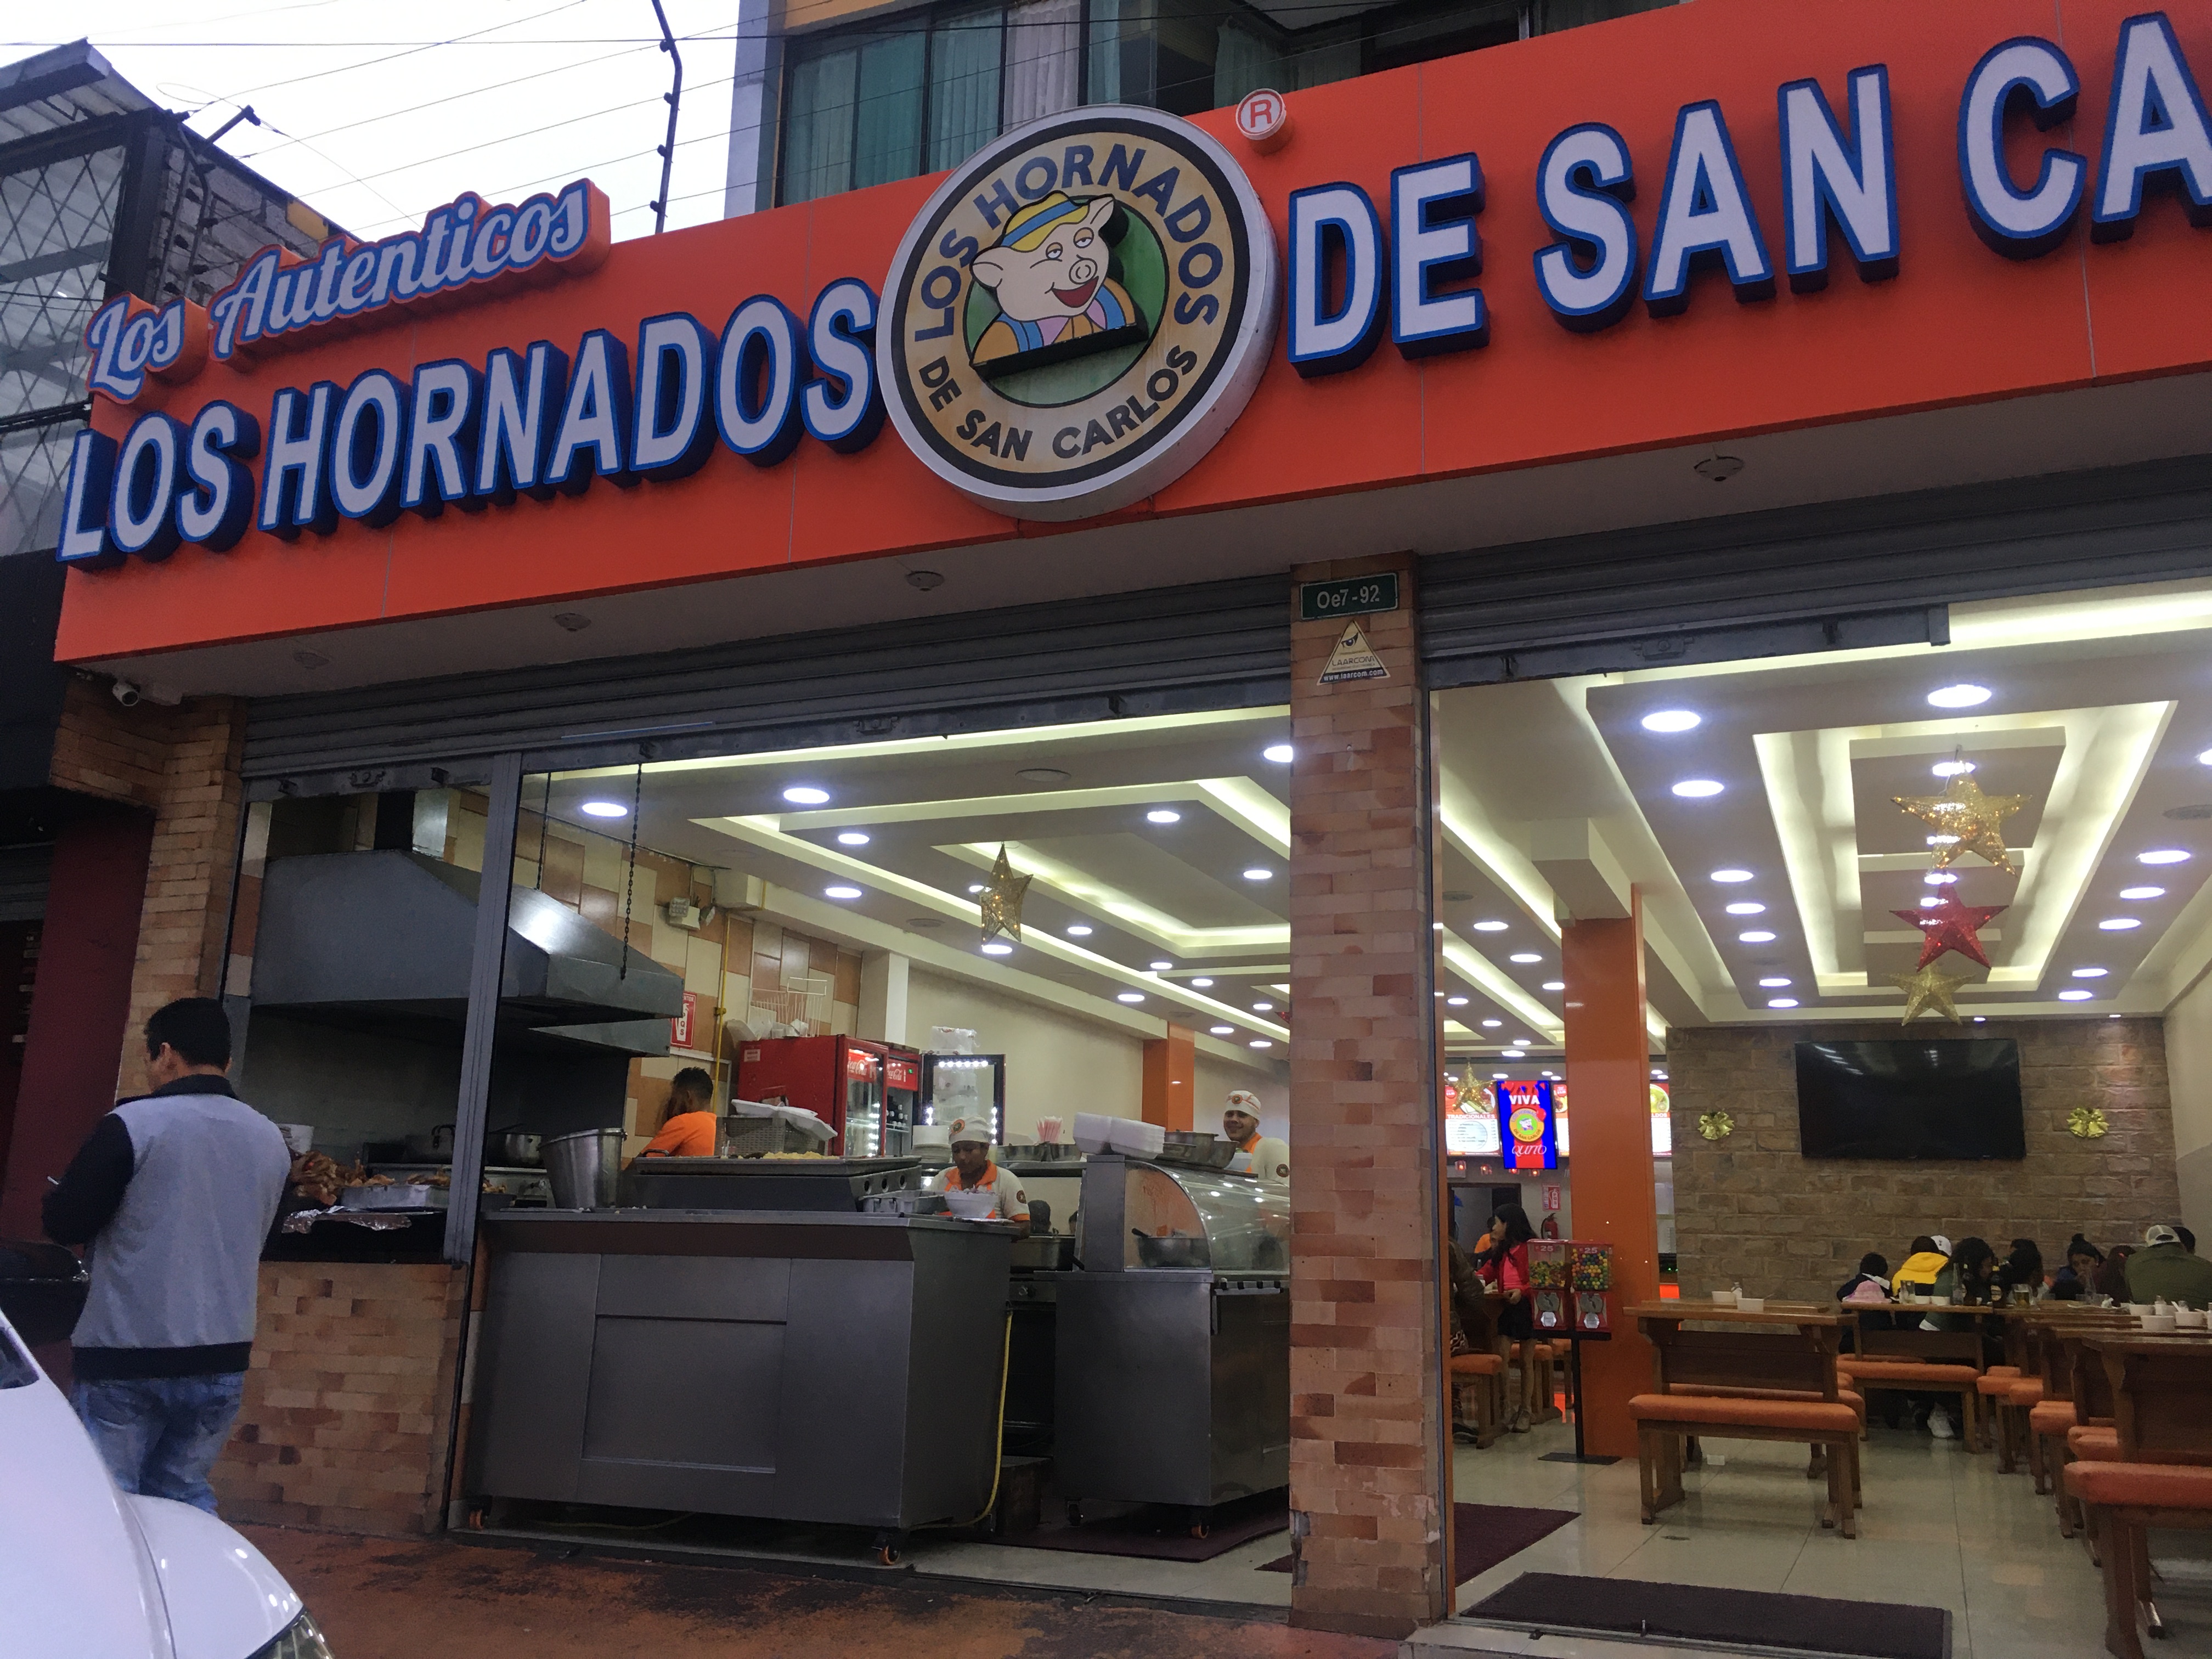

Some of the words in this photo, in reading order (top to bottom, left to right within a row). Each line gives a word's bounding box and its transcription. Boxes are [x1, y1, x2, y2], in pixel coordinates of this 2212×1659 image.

[87, 293, 187, 400] Los
[210, 180, 590, 361] Autenticos
[915, 228, 978, 343] LOS
[972, 143, 1224, 328] HORNADOS
[56, 402, 244, 563] LOS
[258, 278, 878, 532] HORNADOS
[1289, 152, 1484, 363] DE
[1533, 65, 1899, 317] SAN
[918, 354, 963, 413] DE
[956, 408, 1034, 462] SAN
[1052, 344, 1198, 459] CARLOS
[1323, 669, 1383, 681] www.laarcom.com
[1331, 656, 1375, 667] LAARCOM
[1509, 1095, 1541, 1105] VIVA
